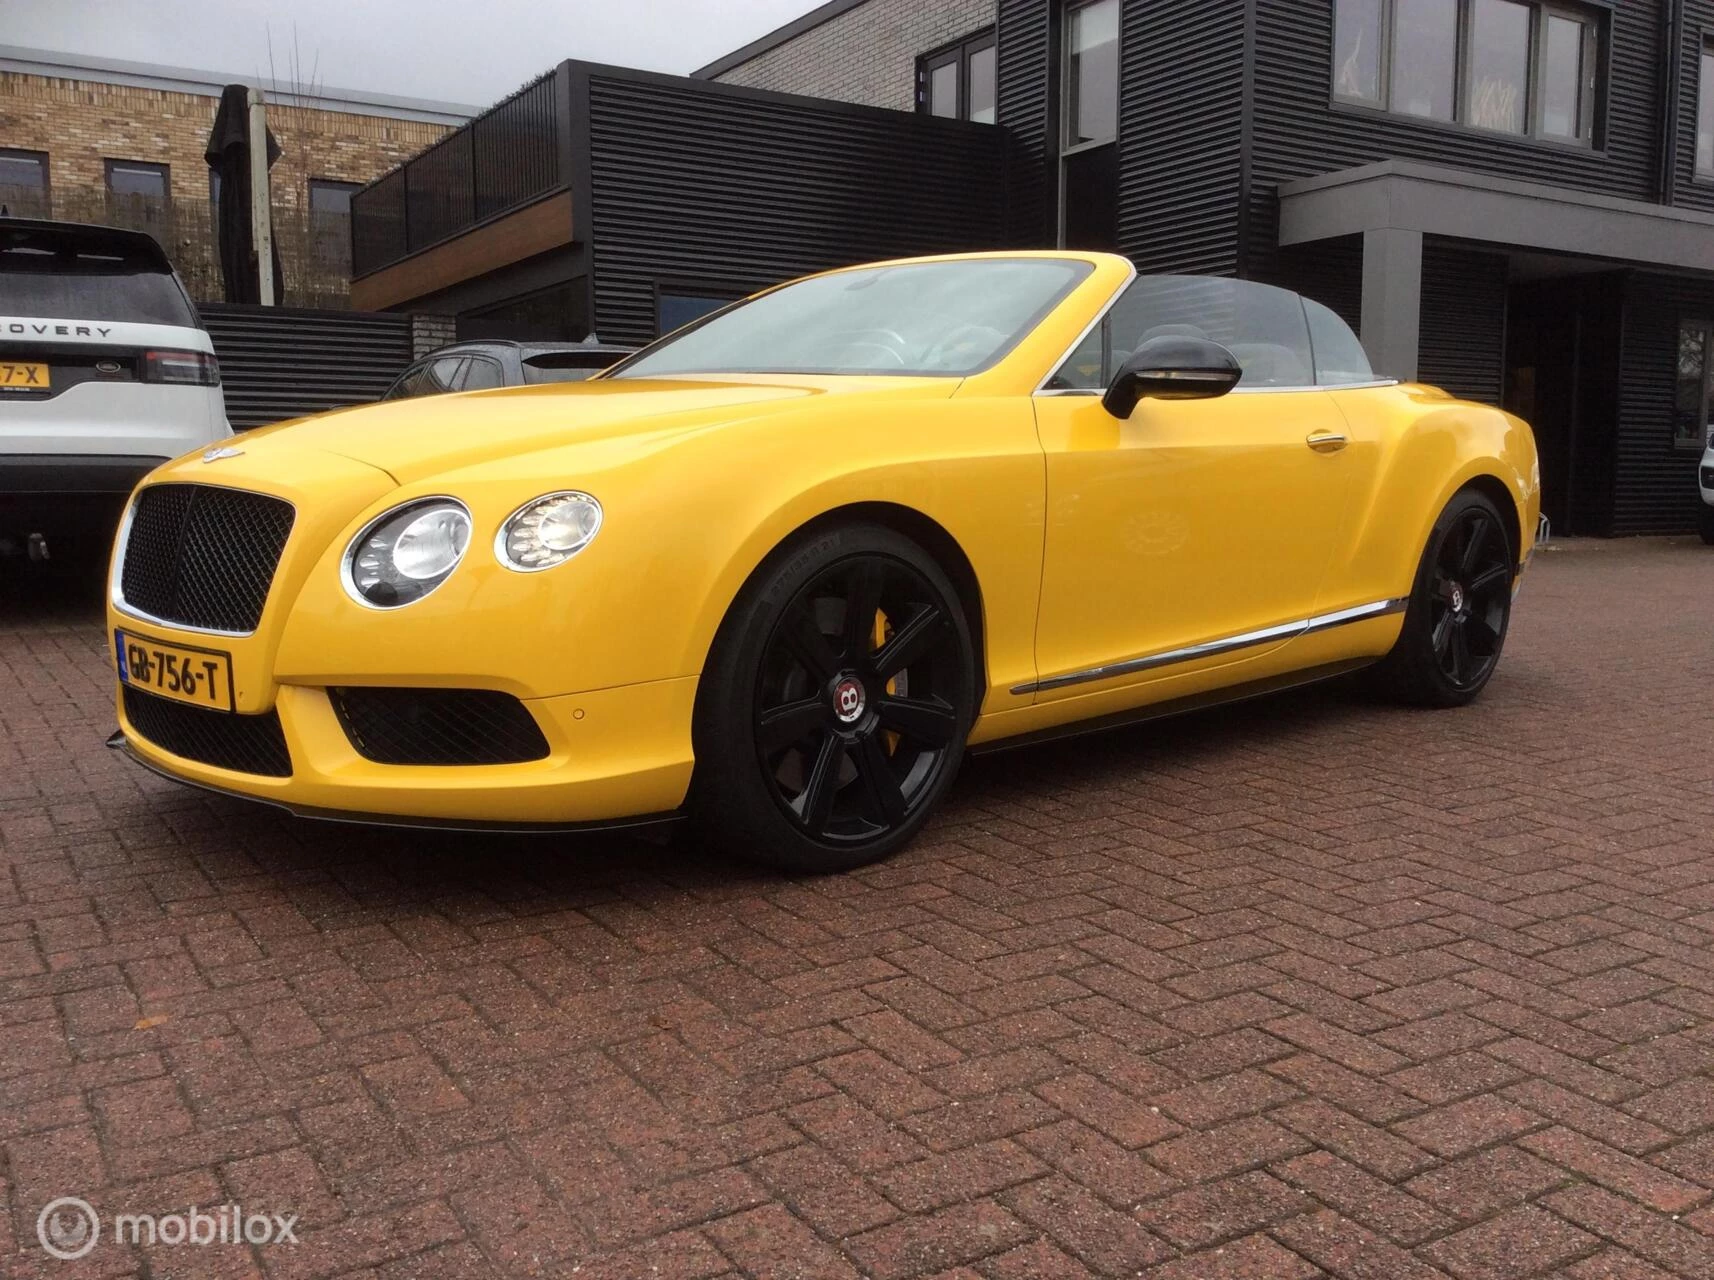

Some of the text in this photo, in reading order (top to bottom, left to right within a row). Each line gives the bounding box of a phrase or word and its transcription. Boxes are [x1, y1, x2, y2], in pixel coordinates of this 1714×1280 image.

[0, 323, 111, 337] OVERY
[0, 366, 38, 384] 7-X
[128, 643, 218, 700] GB-756-T
[841, 687, 858, 712] B
